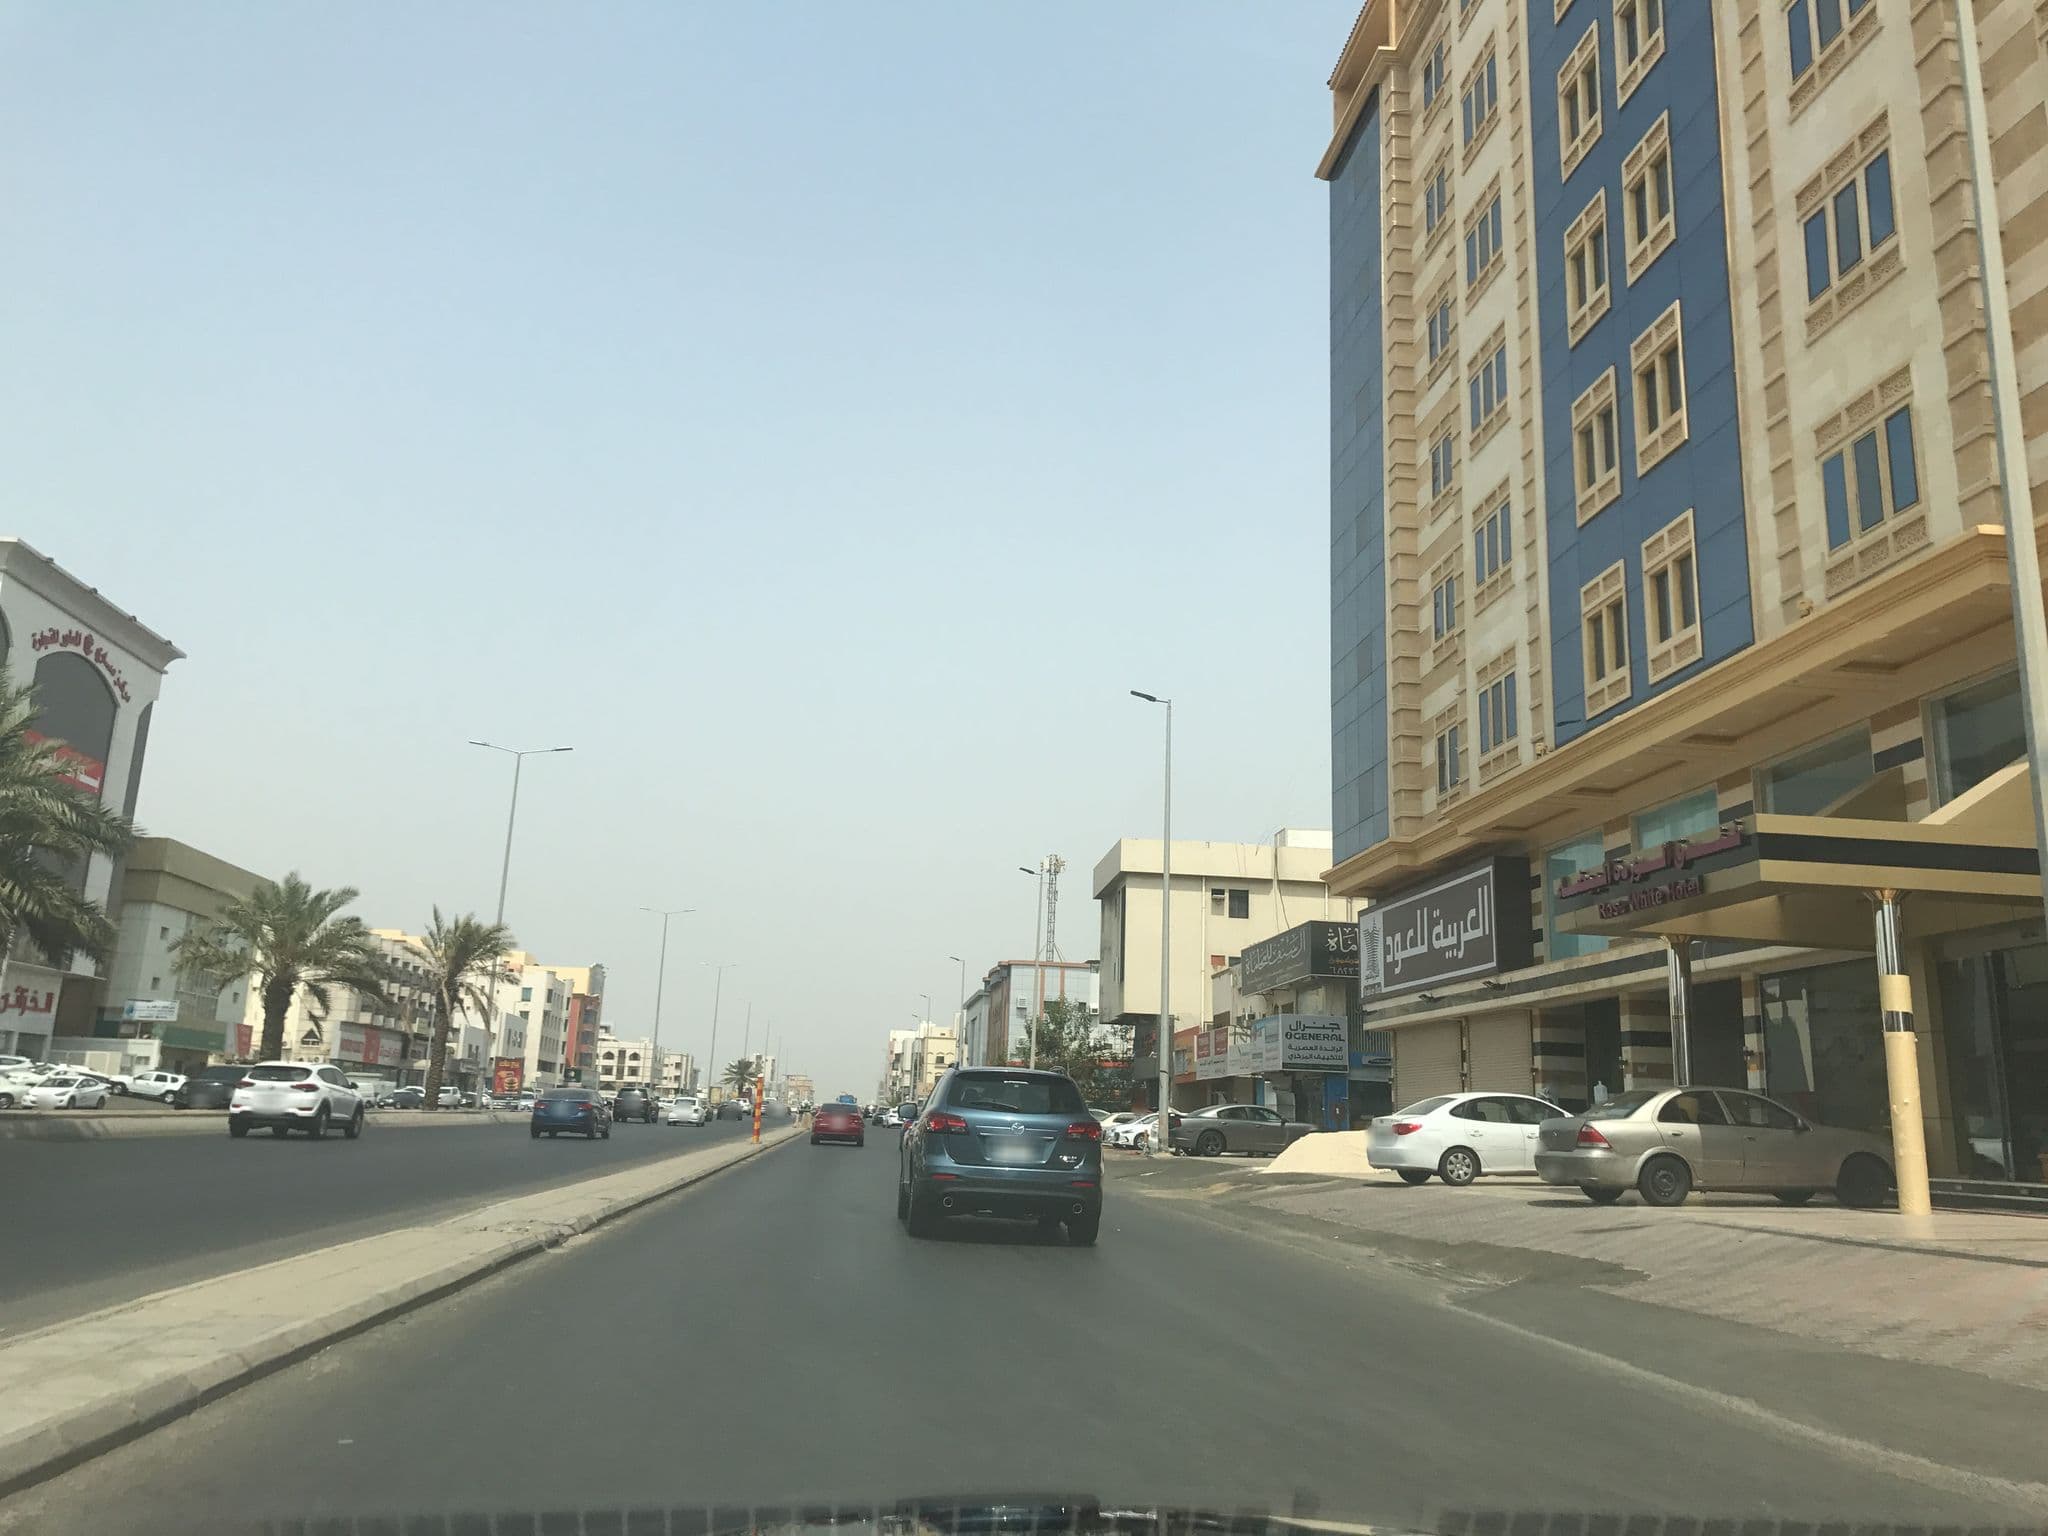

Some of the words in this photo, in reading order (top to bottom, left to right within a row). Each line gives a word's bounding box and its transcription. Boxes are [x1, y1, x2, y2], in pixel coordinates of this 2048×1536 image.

[1385, 907, 1428, 975] للعود
[1432, 885, 1489, 959] العربية
[1289, 1021, 1340, 1032] جنرال
